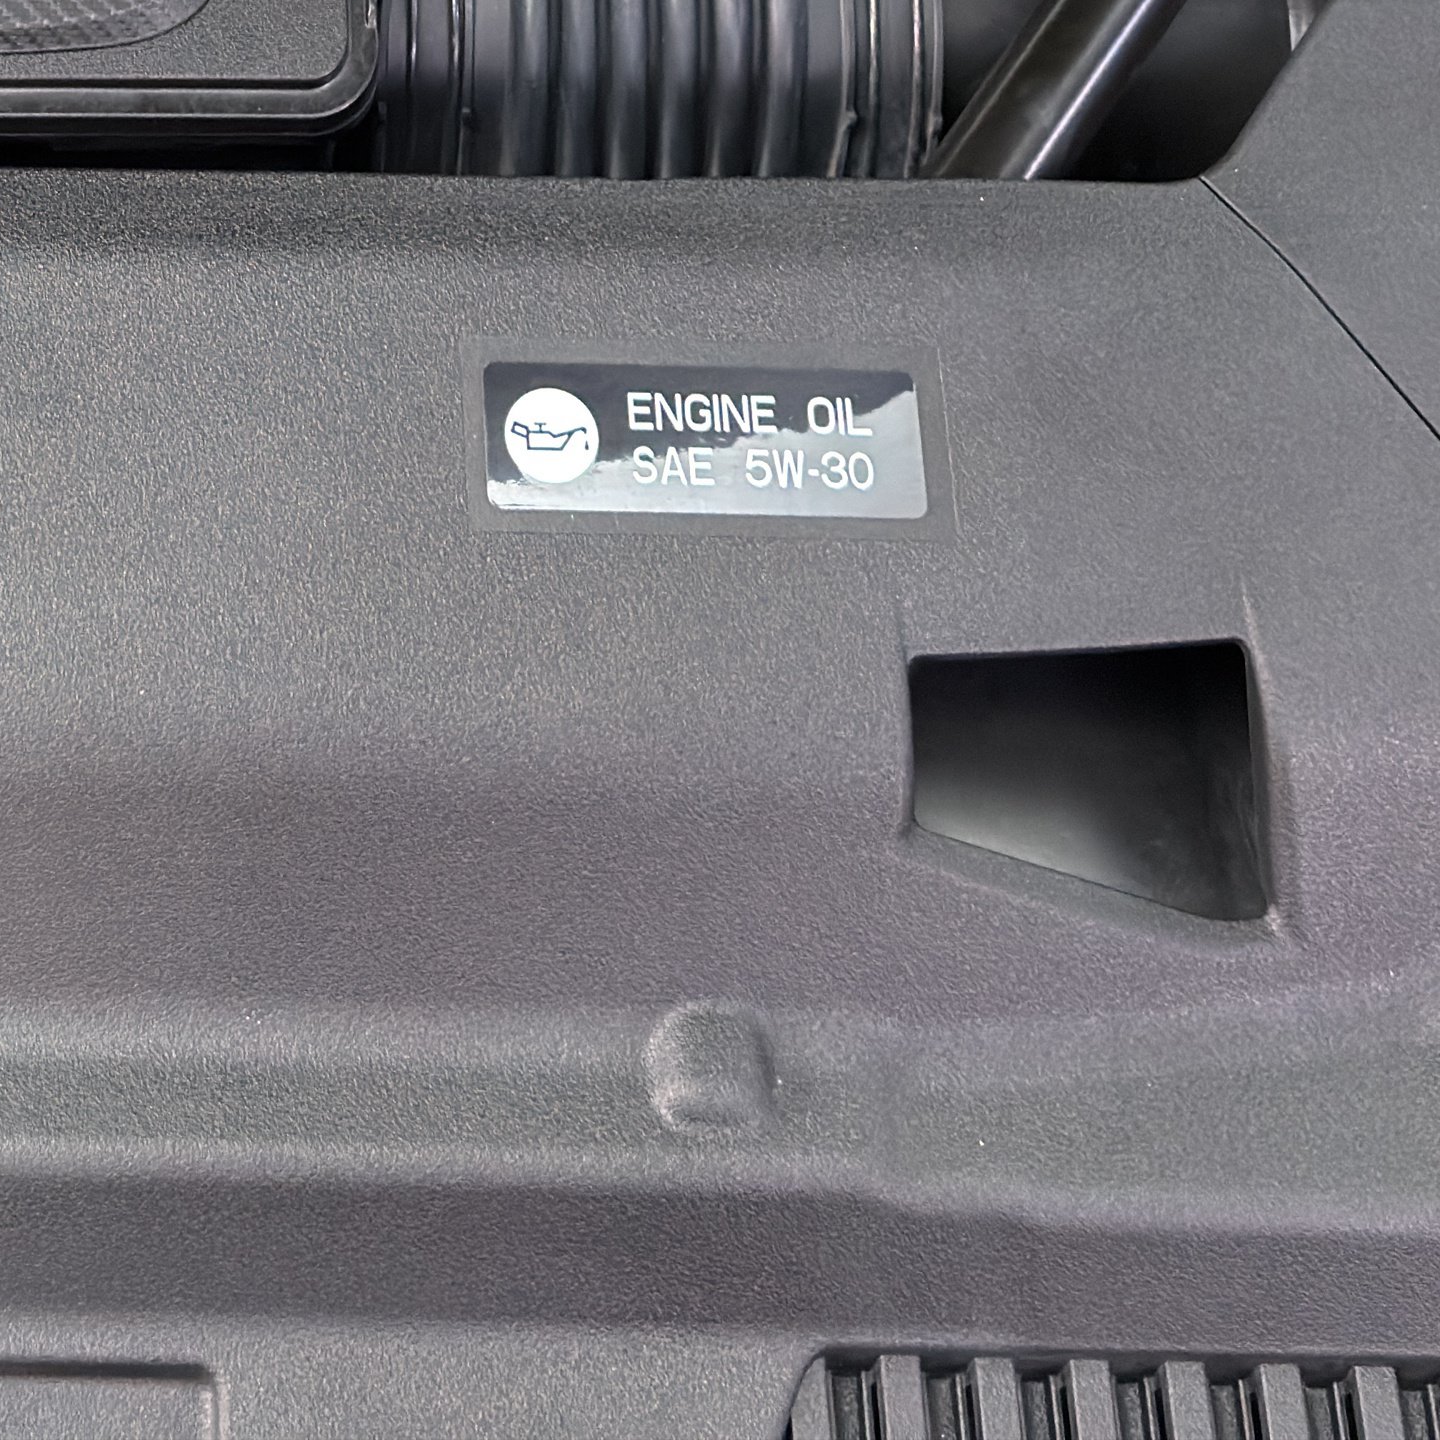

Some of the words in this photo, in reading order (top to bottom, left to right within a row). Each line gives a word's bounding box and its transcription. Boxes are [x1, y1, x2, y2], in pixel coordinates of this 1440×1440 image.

[626, 392, 777, 434] ENGINE
[807, 396, 873, 437] OIL
[632, 446, 716, 486] SAE
[745, 449, 874, 492] 5W-30
